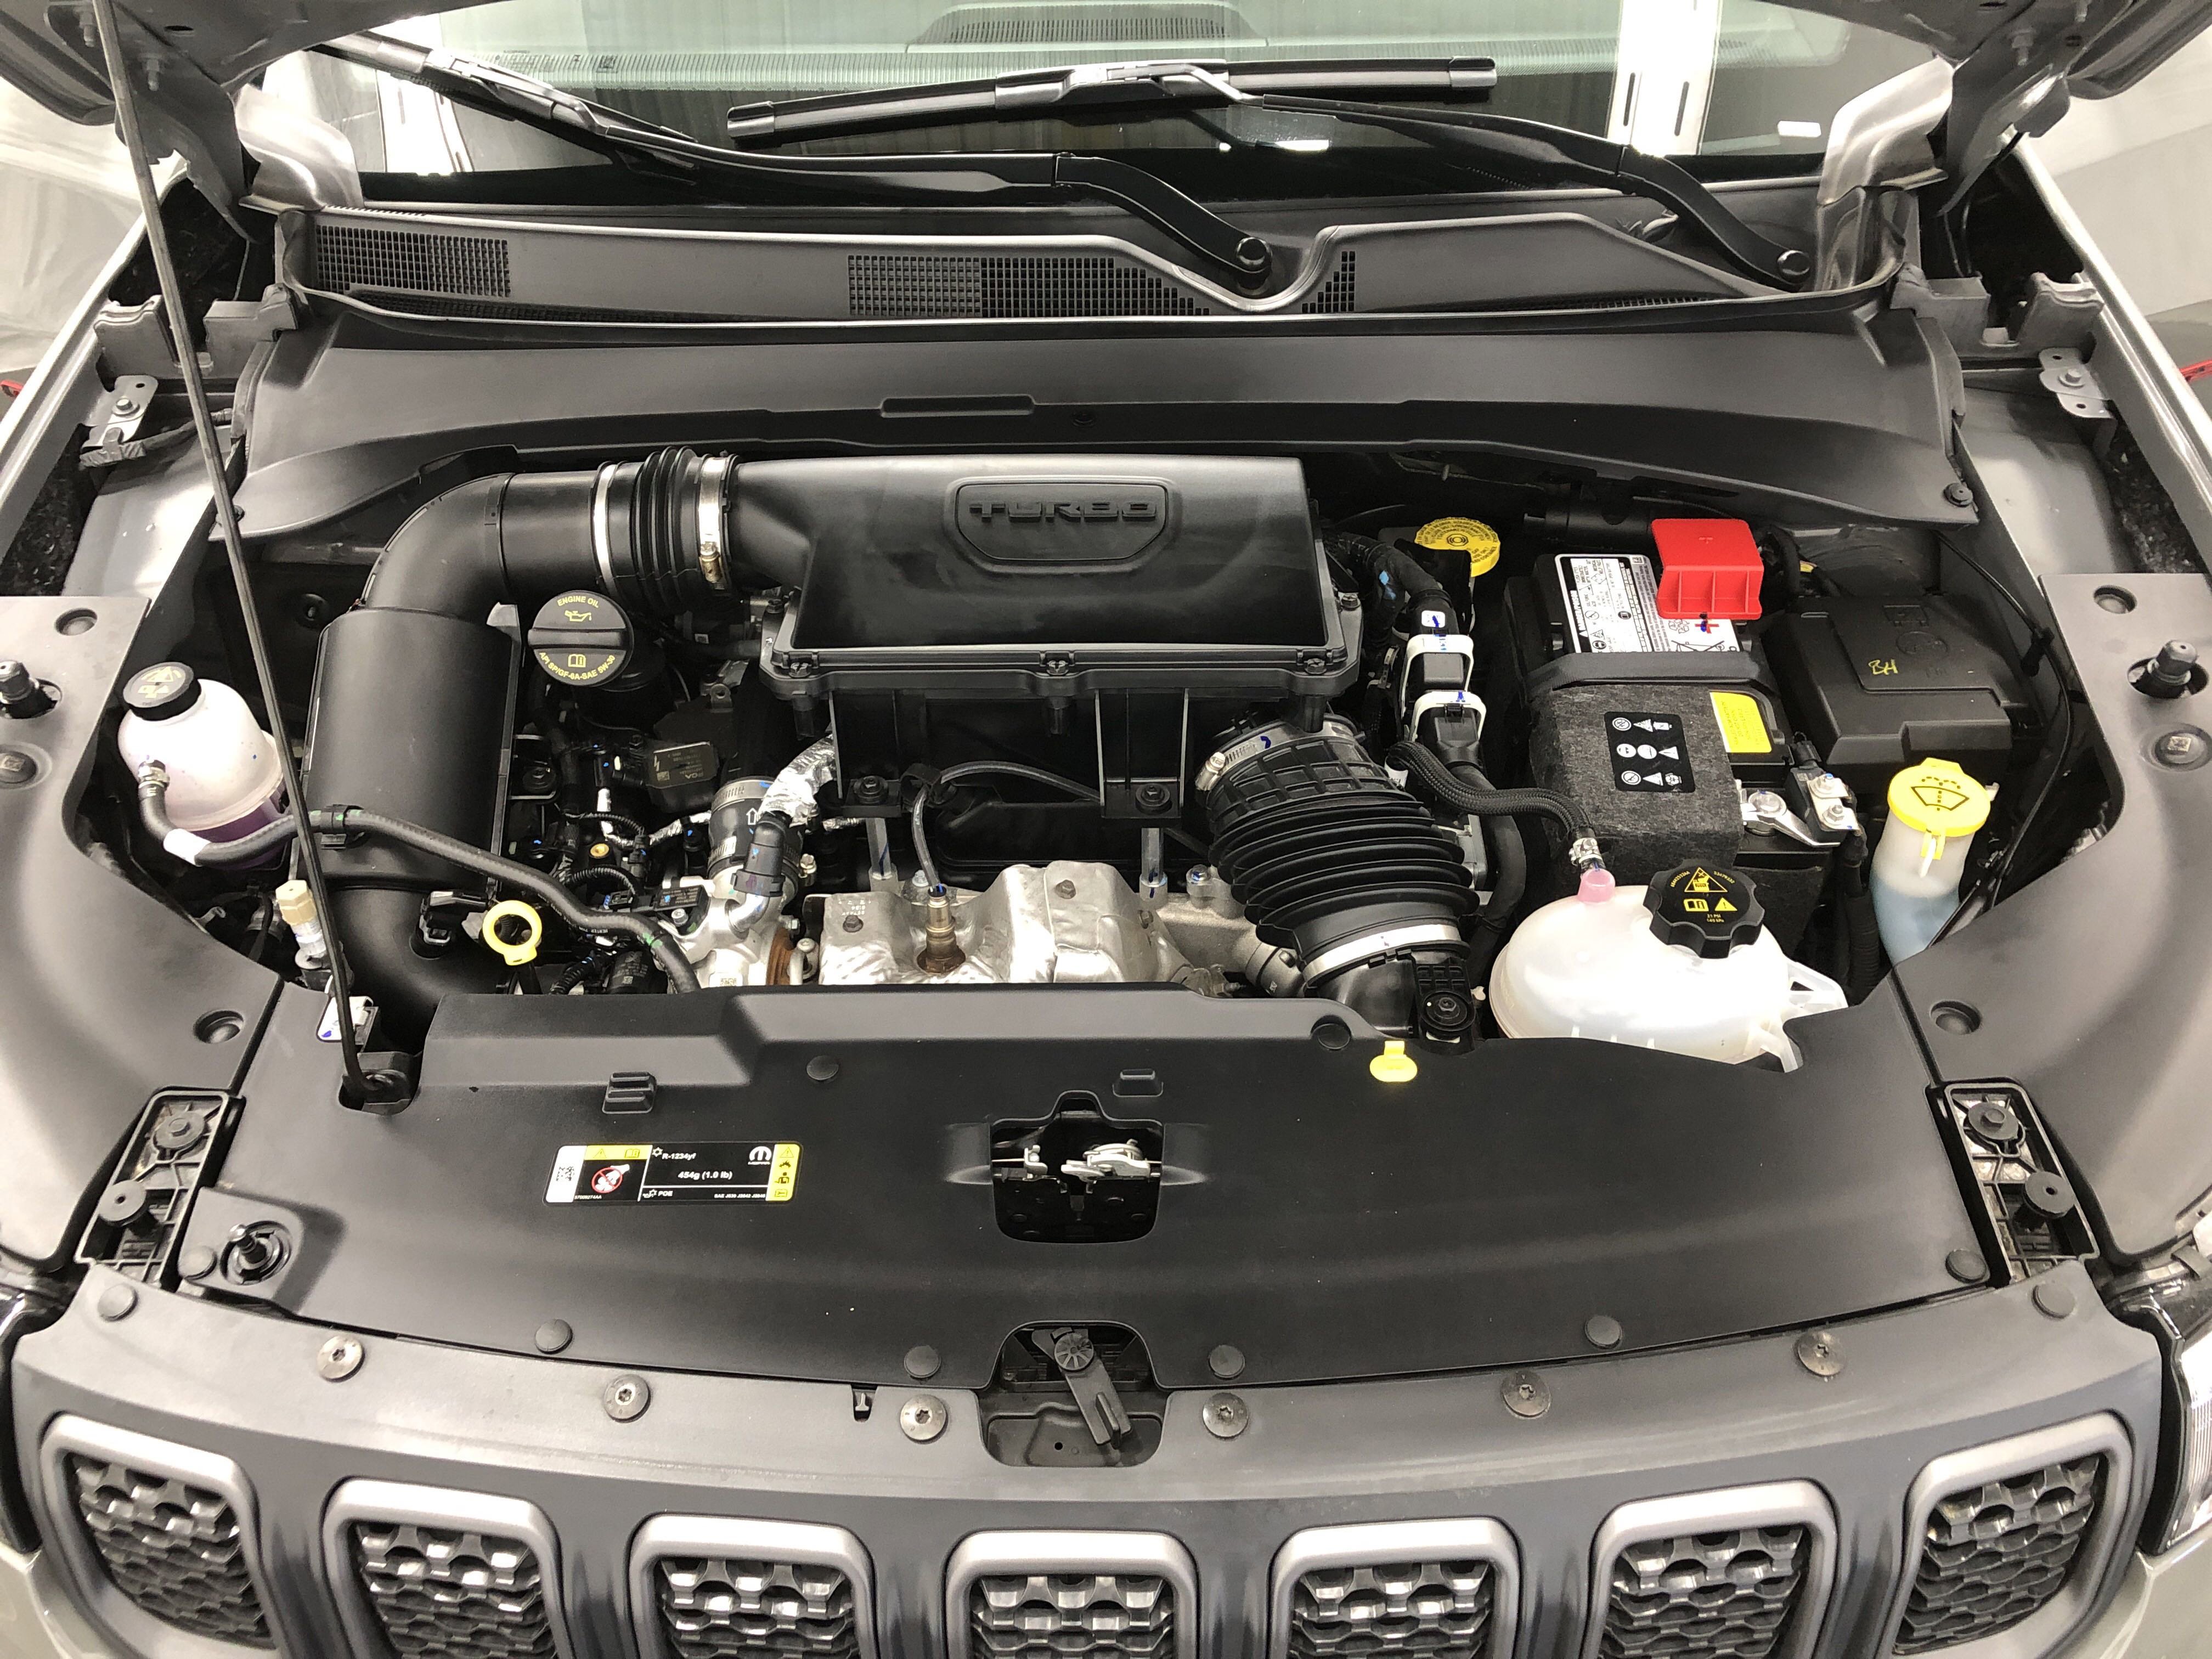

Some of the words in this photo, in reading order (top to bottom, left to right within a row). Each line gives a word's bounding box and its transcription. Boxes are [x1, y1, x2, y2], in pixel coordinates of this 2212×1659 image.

[969, 501, 1156, 522] TURBO
[557, 596, 586, 606] ENGINE
[588, 597, 599, 608] OIL
[539, 652, 550, 664] API
[597, 655, 616, 674] 5W-30
[662, 1153, 696, 1161] R-1234yf
[678, 1171, 700, 1180] 454g
[702, 1171, 719, 1180] (1.0
[720, 1171, 732, 1180] lb)
